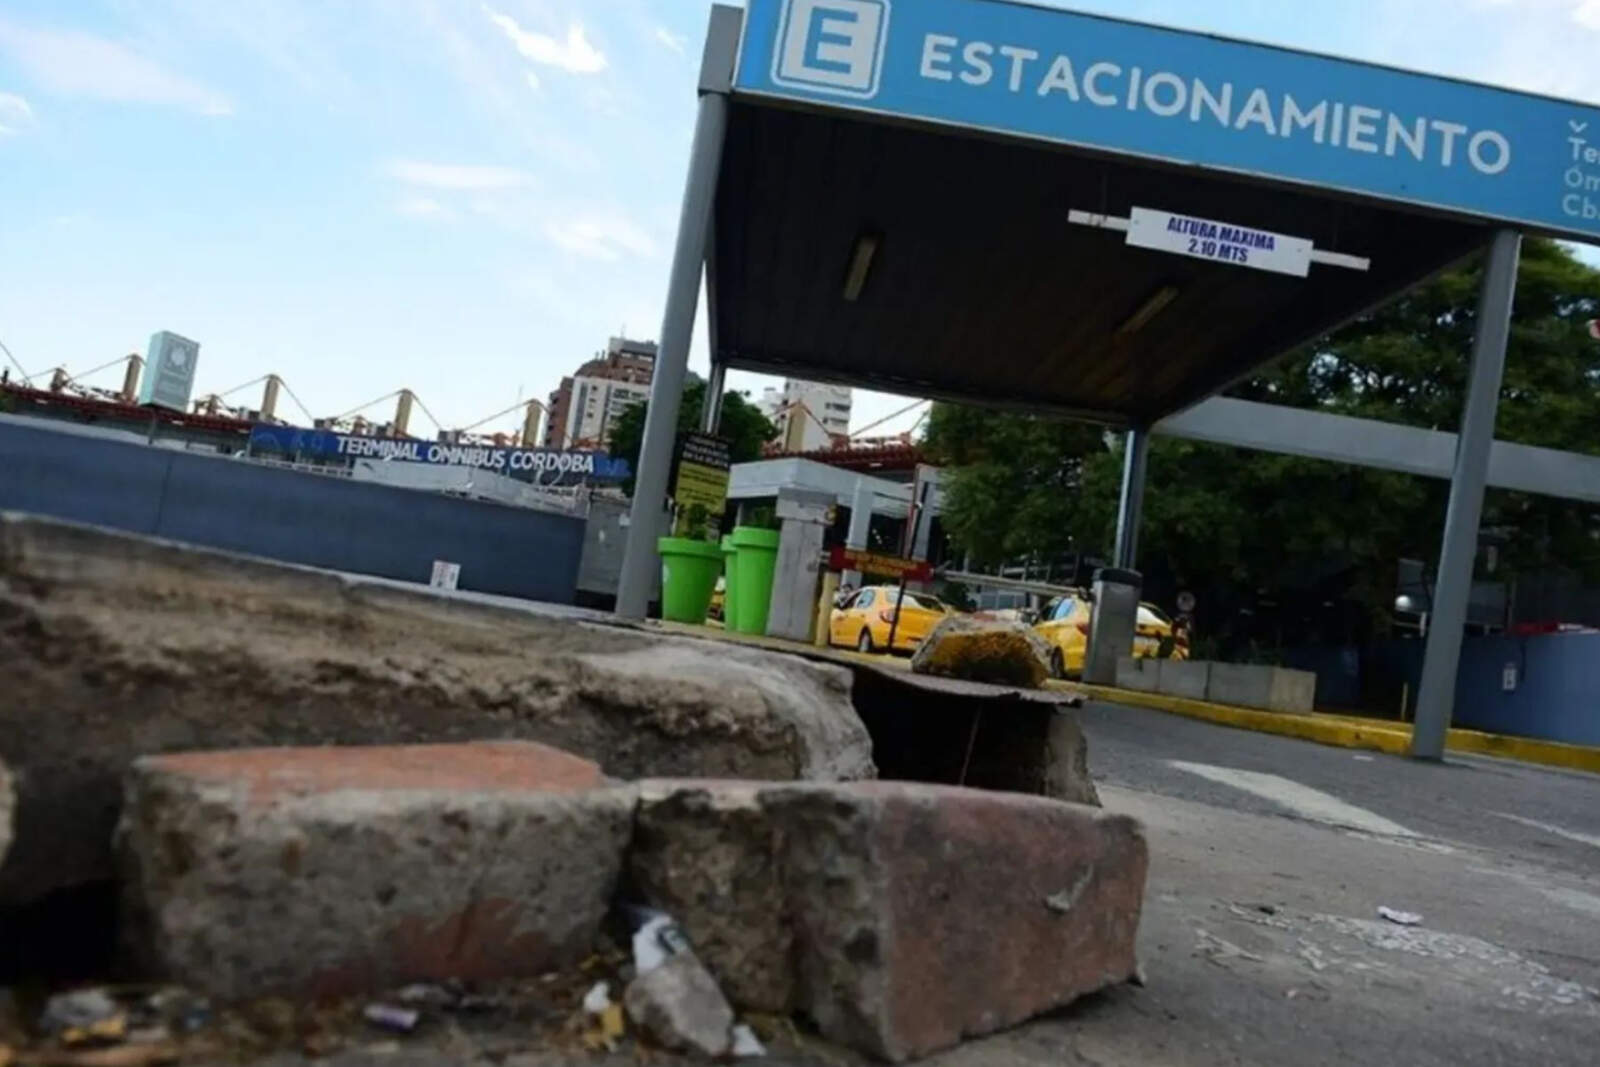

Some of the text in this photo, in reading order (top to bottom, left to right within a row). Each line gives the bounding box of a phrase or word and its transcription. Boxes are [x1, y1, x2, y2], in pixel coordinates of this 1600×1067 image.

[802, 6, 1510, 175] E ESTACIONAMIENTO
[1567, 137, 1600, 165] Te
[1562, 194, 1600, 219] Cb
[1167, 216, 1275, 251] ALTURA MAXIMA
[1188, 238, 1249, 263] 2.10 MTS
[336, 435, 422, 461] TERMINAL
[510, 451, 594, 474] CORDOBA
